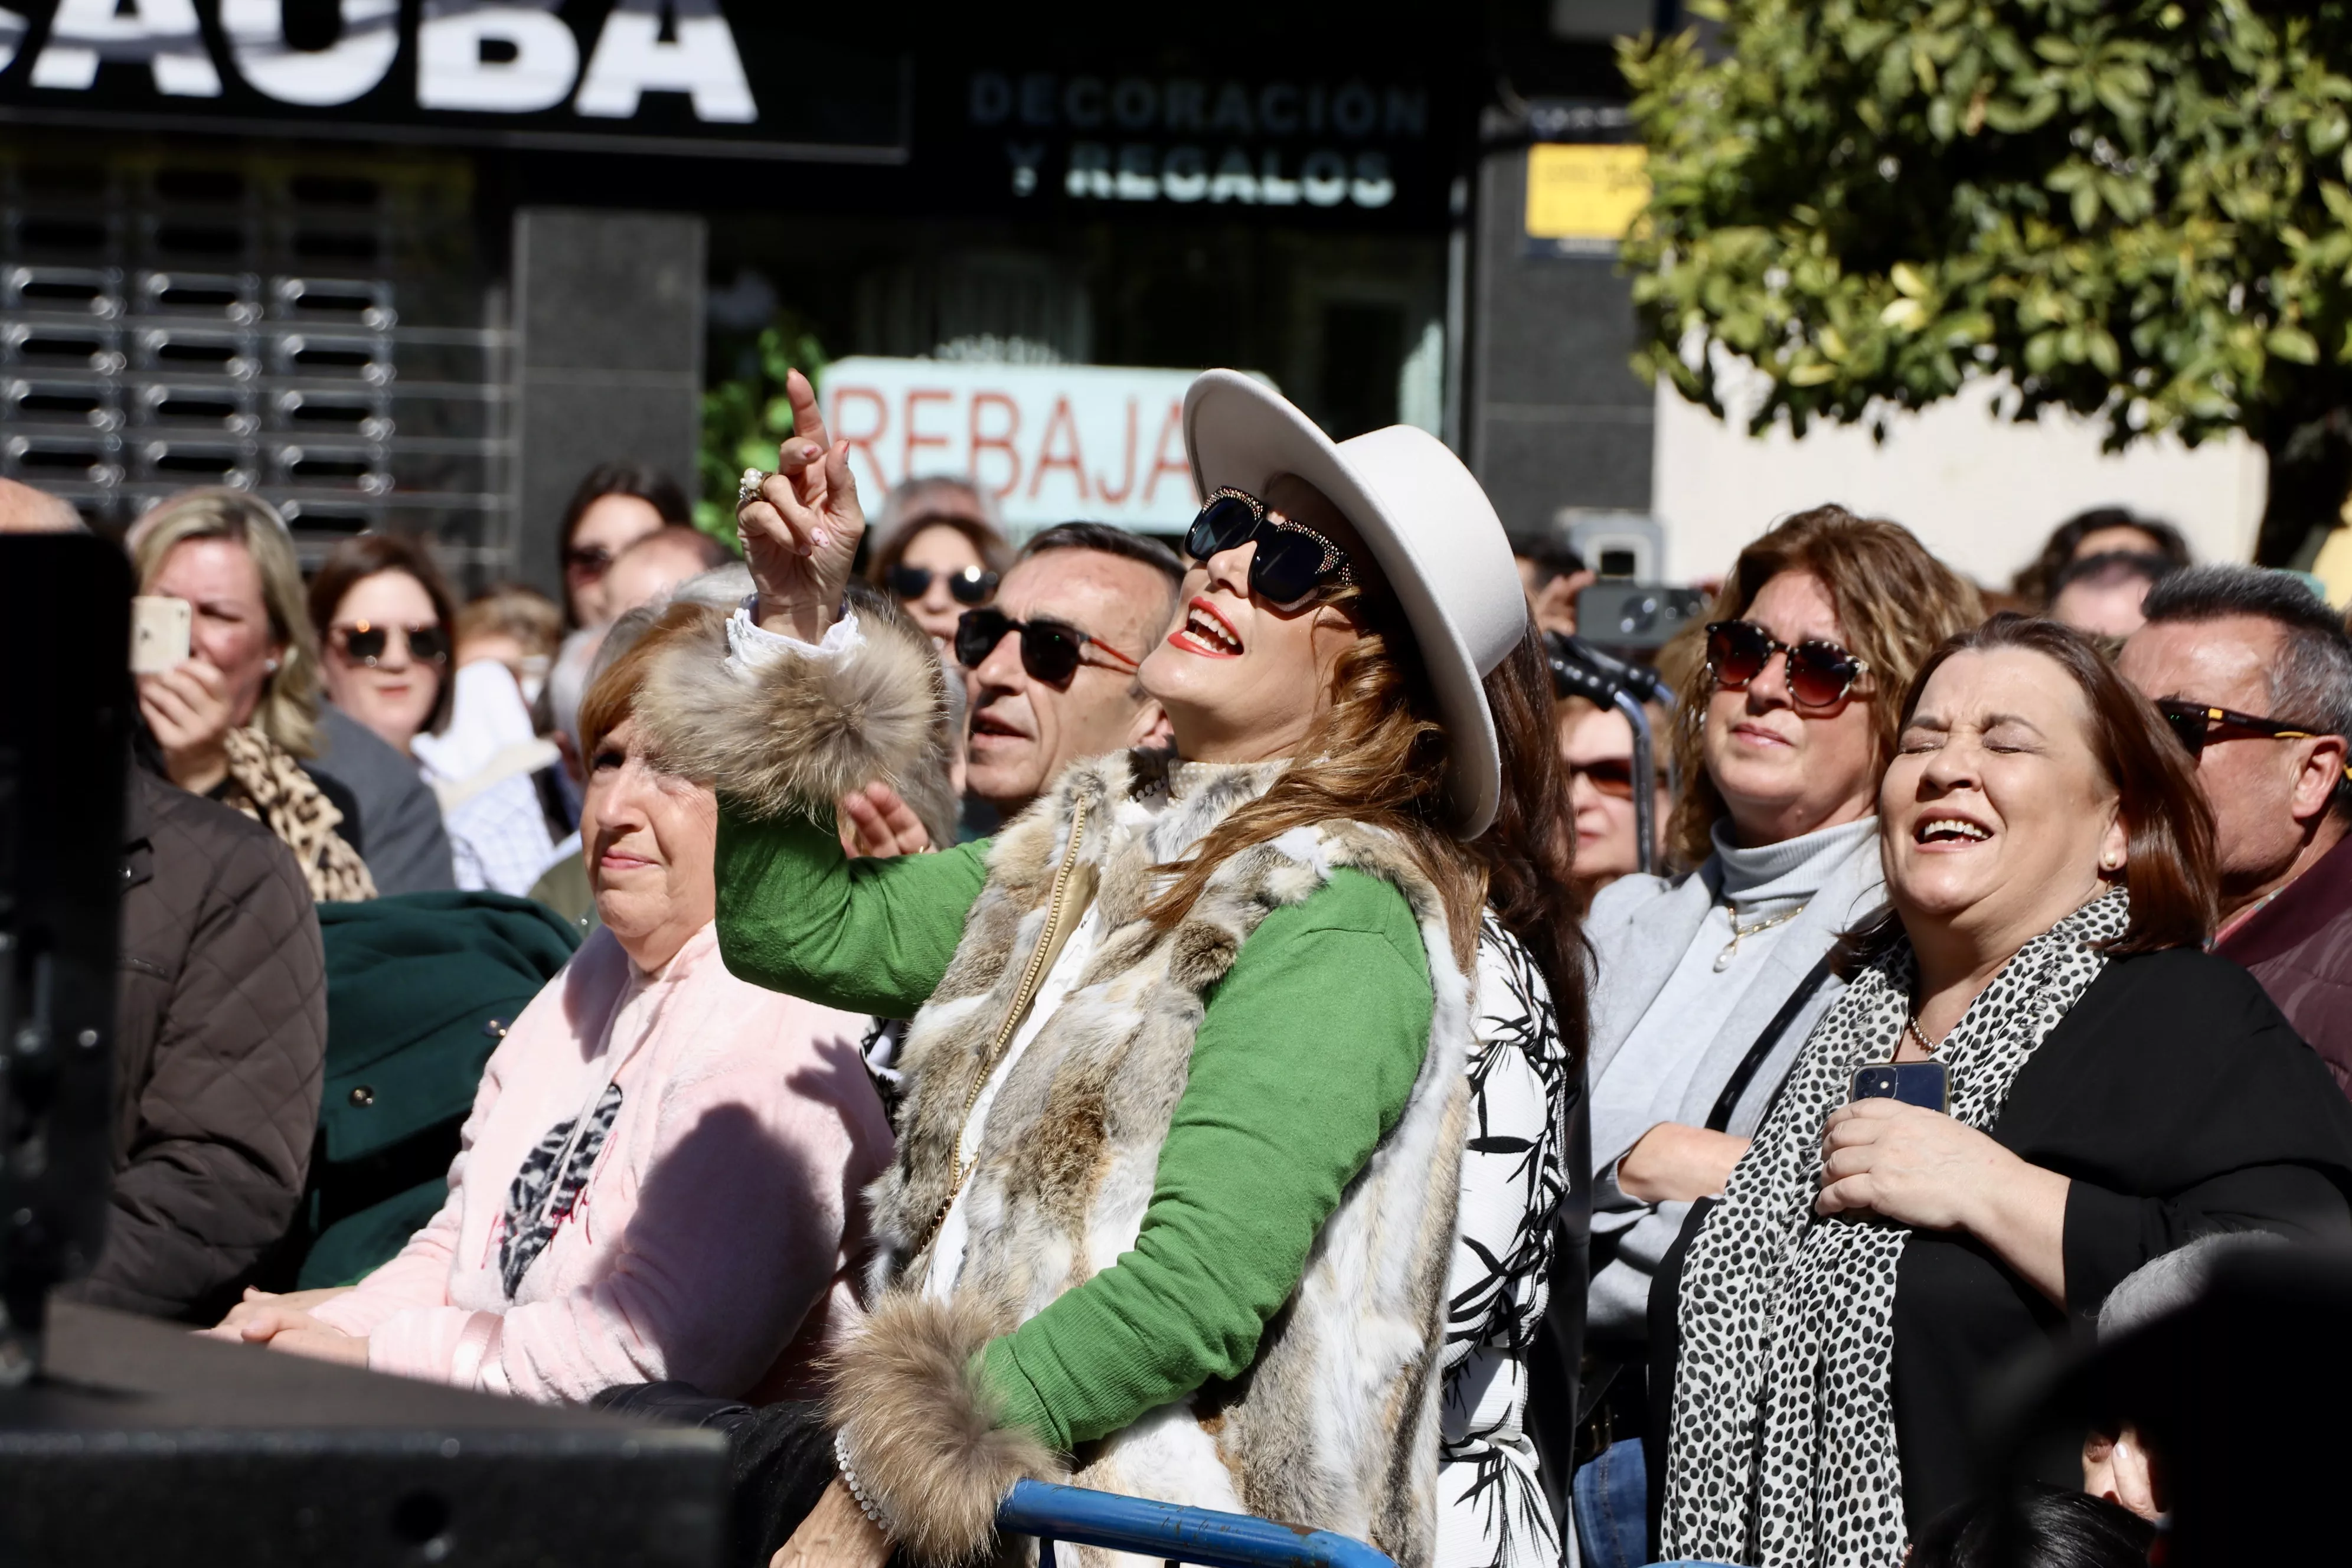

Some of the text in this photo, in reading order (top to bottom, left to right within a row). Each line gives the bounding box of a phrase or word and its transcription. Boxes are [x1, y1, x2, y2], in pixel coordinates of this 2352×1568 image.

[968, 71, 1429, 138] DECORACIÓN
[1004, 139, 1397, 208] Y REGALOS
